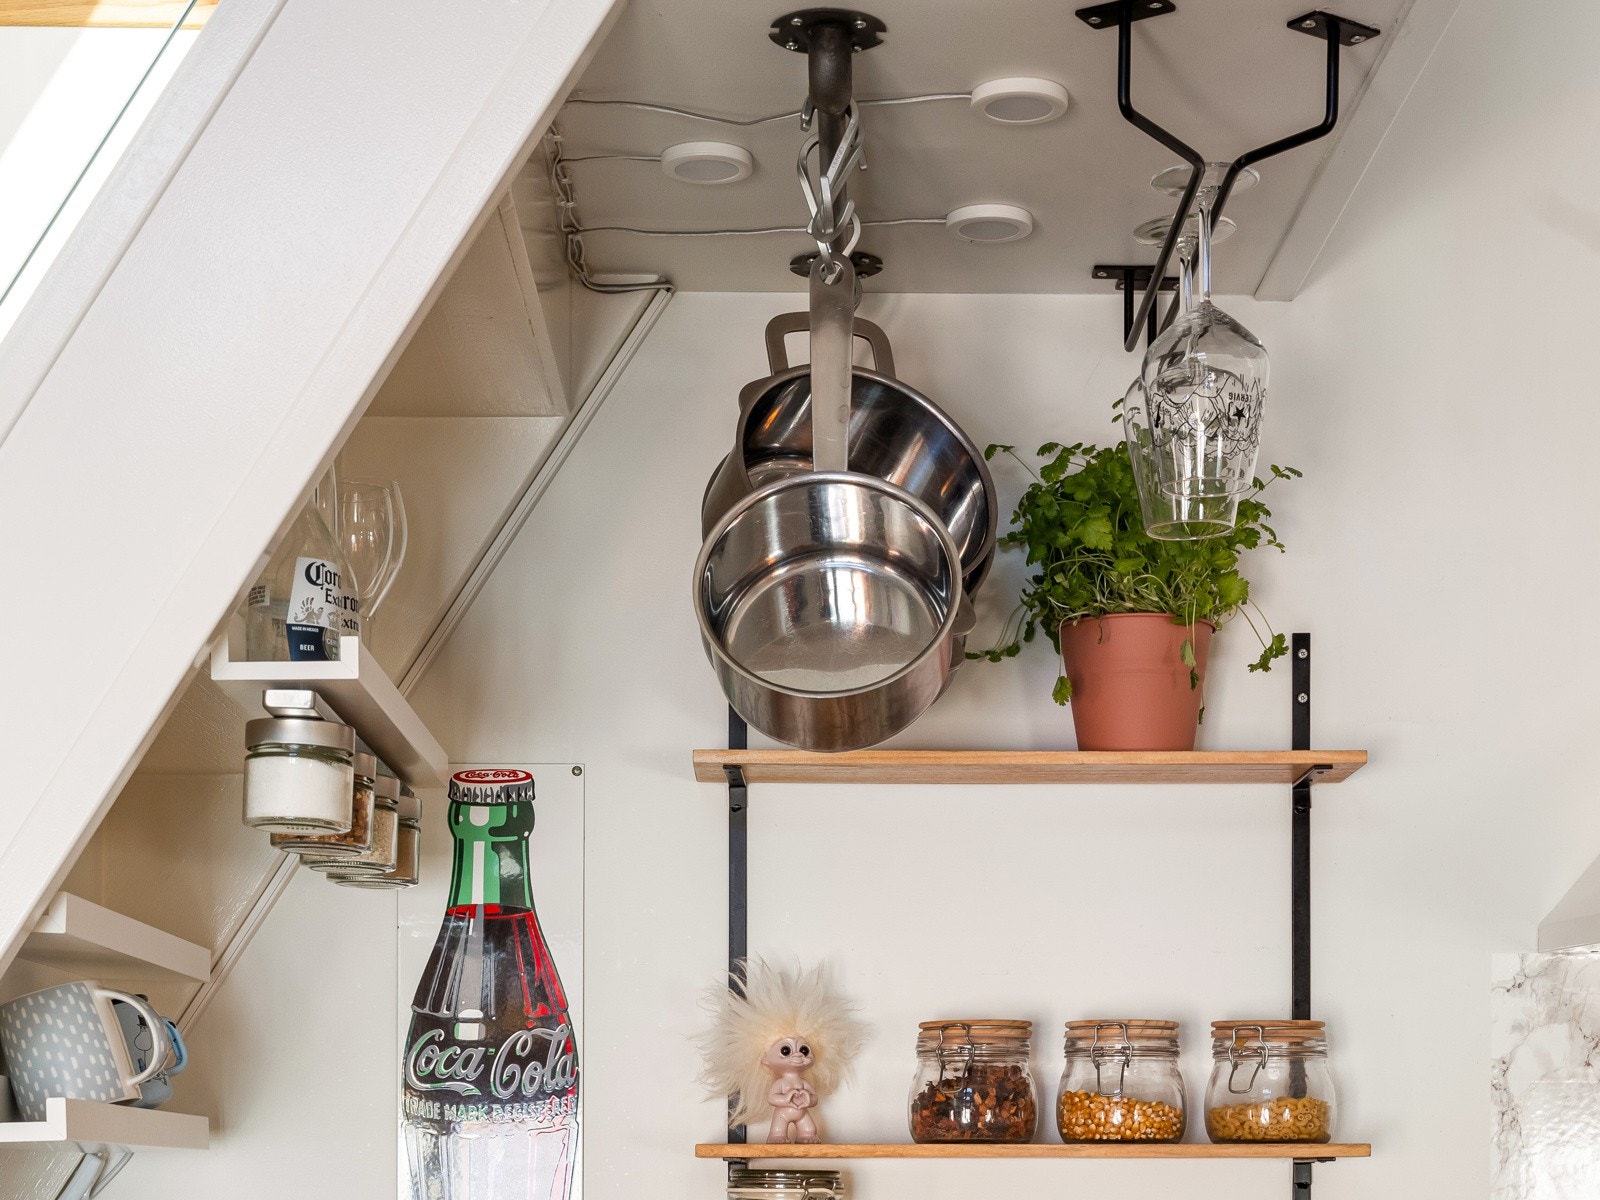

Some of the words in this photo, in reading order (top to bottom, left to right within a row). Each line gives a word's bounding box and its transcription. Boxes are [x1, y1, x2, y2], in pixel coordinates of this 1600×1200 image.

[299, 644, 315, 652] BEER
[464, 770, 519, 779] Coca-Cola
[406, 1023, 579, 1099] Coca-Cola
[404, 1095, 441, 1120] TRADE
[443, 1103, 489, 1121] MARK
[491, 1095, 577, 1122] REGISTERED
